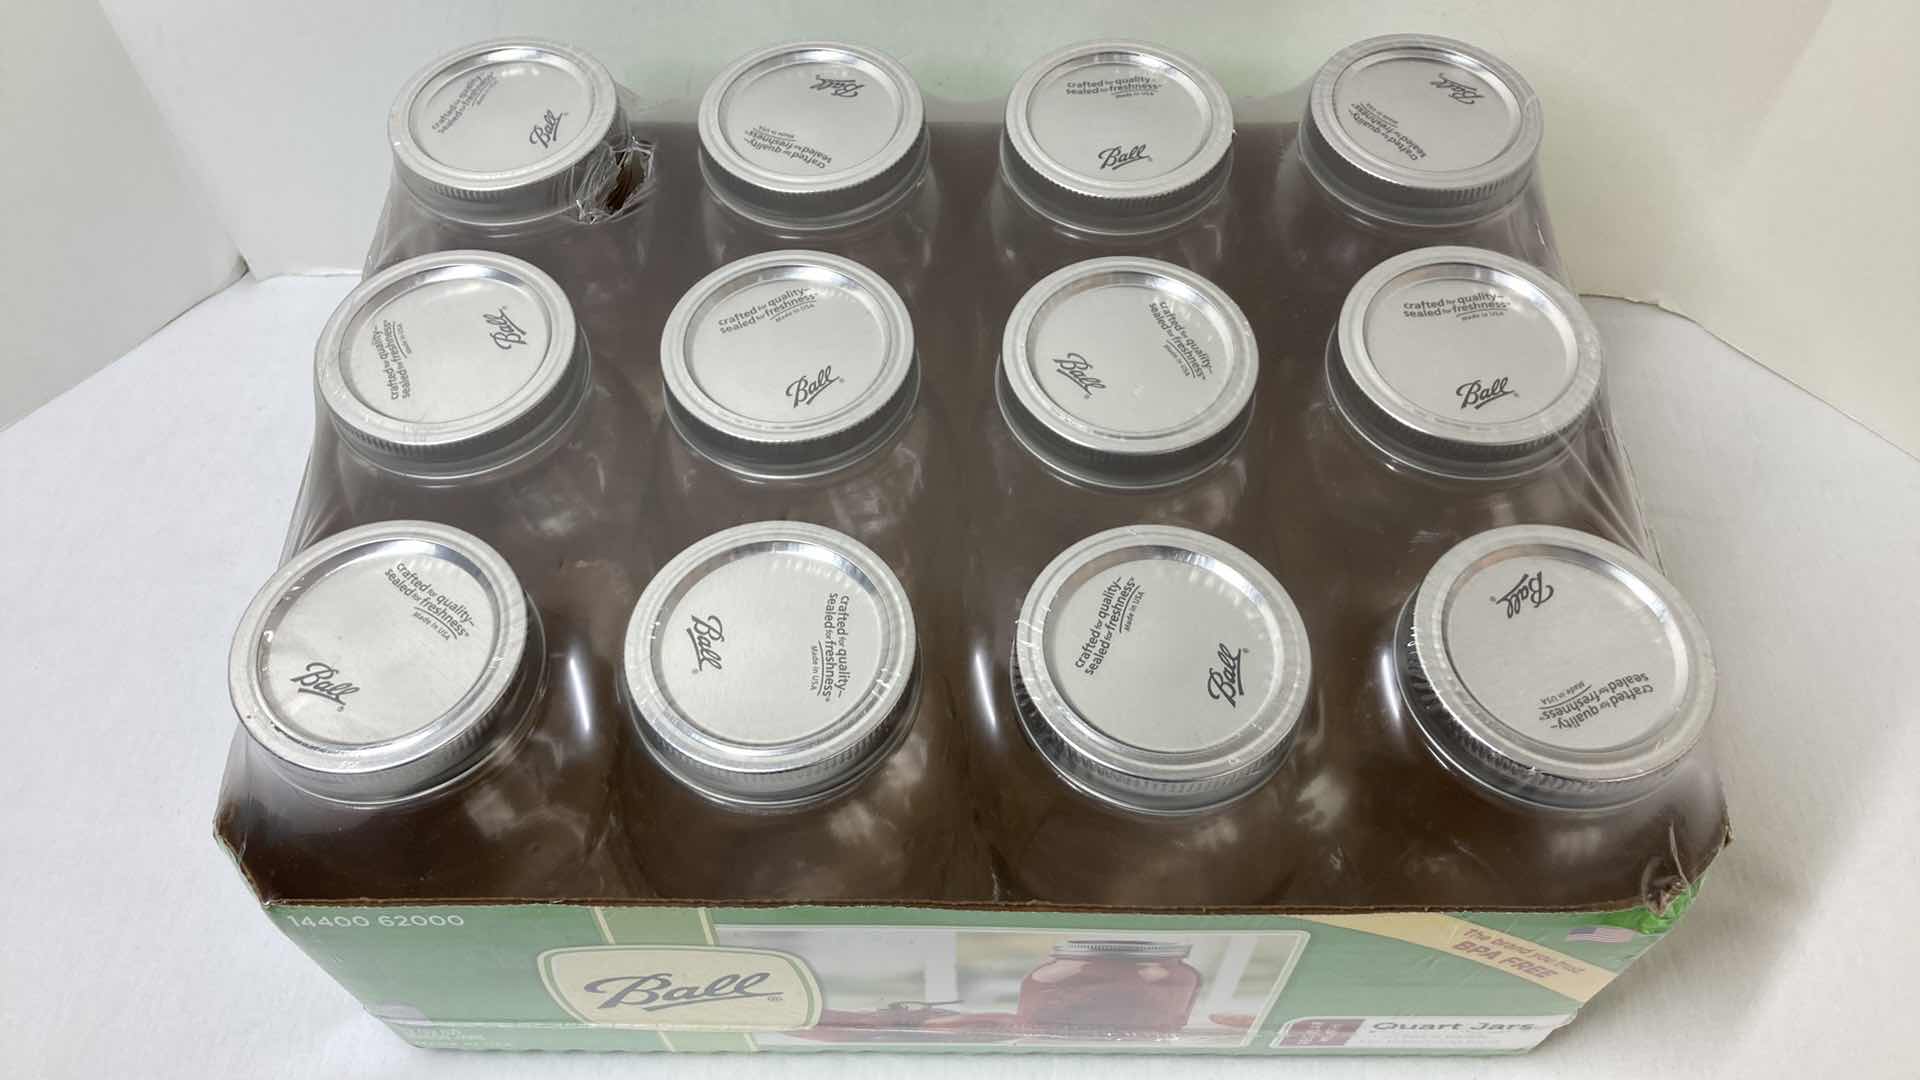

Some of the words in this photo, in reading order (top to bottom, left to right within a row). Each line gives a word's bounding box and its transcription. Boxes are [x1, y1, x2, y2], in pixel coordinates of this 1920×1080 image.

[810, 75, 864, 97] Ball
[1430, 73, 1484, 105] Ball
[529, 109, 563, 148] Ball
[1098, 144, 1151, 170] Ball
[718, 306, 757, 326] crafted
[1150, 304, 1169, 330] sealed
[1160, 301, 1182, 332] crafted
[1403, 299, 1444, 310] crafted
[1403, 308, 1441, 318] sealed
[483, 308, 527, 350] Ball
[720, 316, 756, 334] sealed
[1053, 353, 1106, 395] Ball
[1180, 365, 1190, 376] USA
[785, 365, 840, 408] Ball
[1456, 377, 1514, 410] Ball
[385, 568, 413, 596] sealed
[397, 562, 428, 592] crafted
[1135, 591, 1144, 604] USA
[1496, 571, 1554, 619] Ball
[824, 593, 838, 628] sealed
[838, 595, 850, 635] crafted
[437, 626, 451, 640] USA
[686, 615, 725, 671] Ball
[1075, 629, 1100, 669] crafted
[1085, 640, 1110, 676] sealed
[290, 662, 360, 706] Ball
[810, 675, 818, 690] USA
[1208, 643, 1244, 708] Ball
[1608, 673, 1649, 689] sealed
[1541, 695, 1556, 705] USA
[1611, 684, 1654, 708] crafted
[287, 914, 370, 928] 14400
[377, 914, 465, 928] 62000
[1452, 940, 1502, 960] BPA
[1498, 957, 1559, 978] FREE
[584, 972, 784, 1012] Ball
[1372, 1021, 1464, 1031] Quart
[1469, 1021, 1537, 1031] Jars
